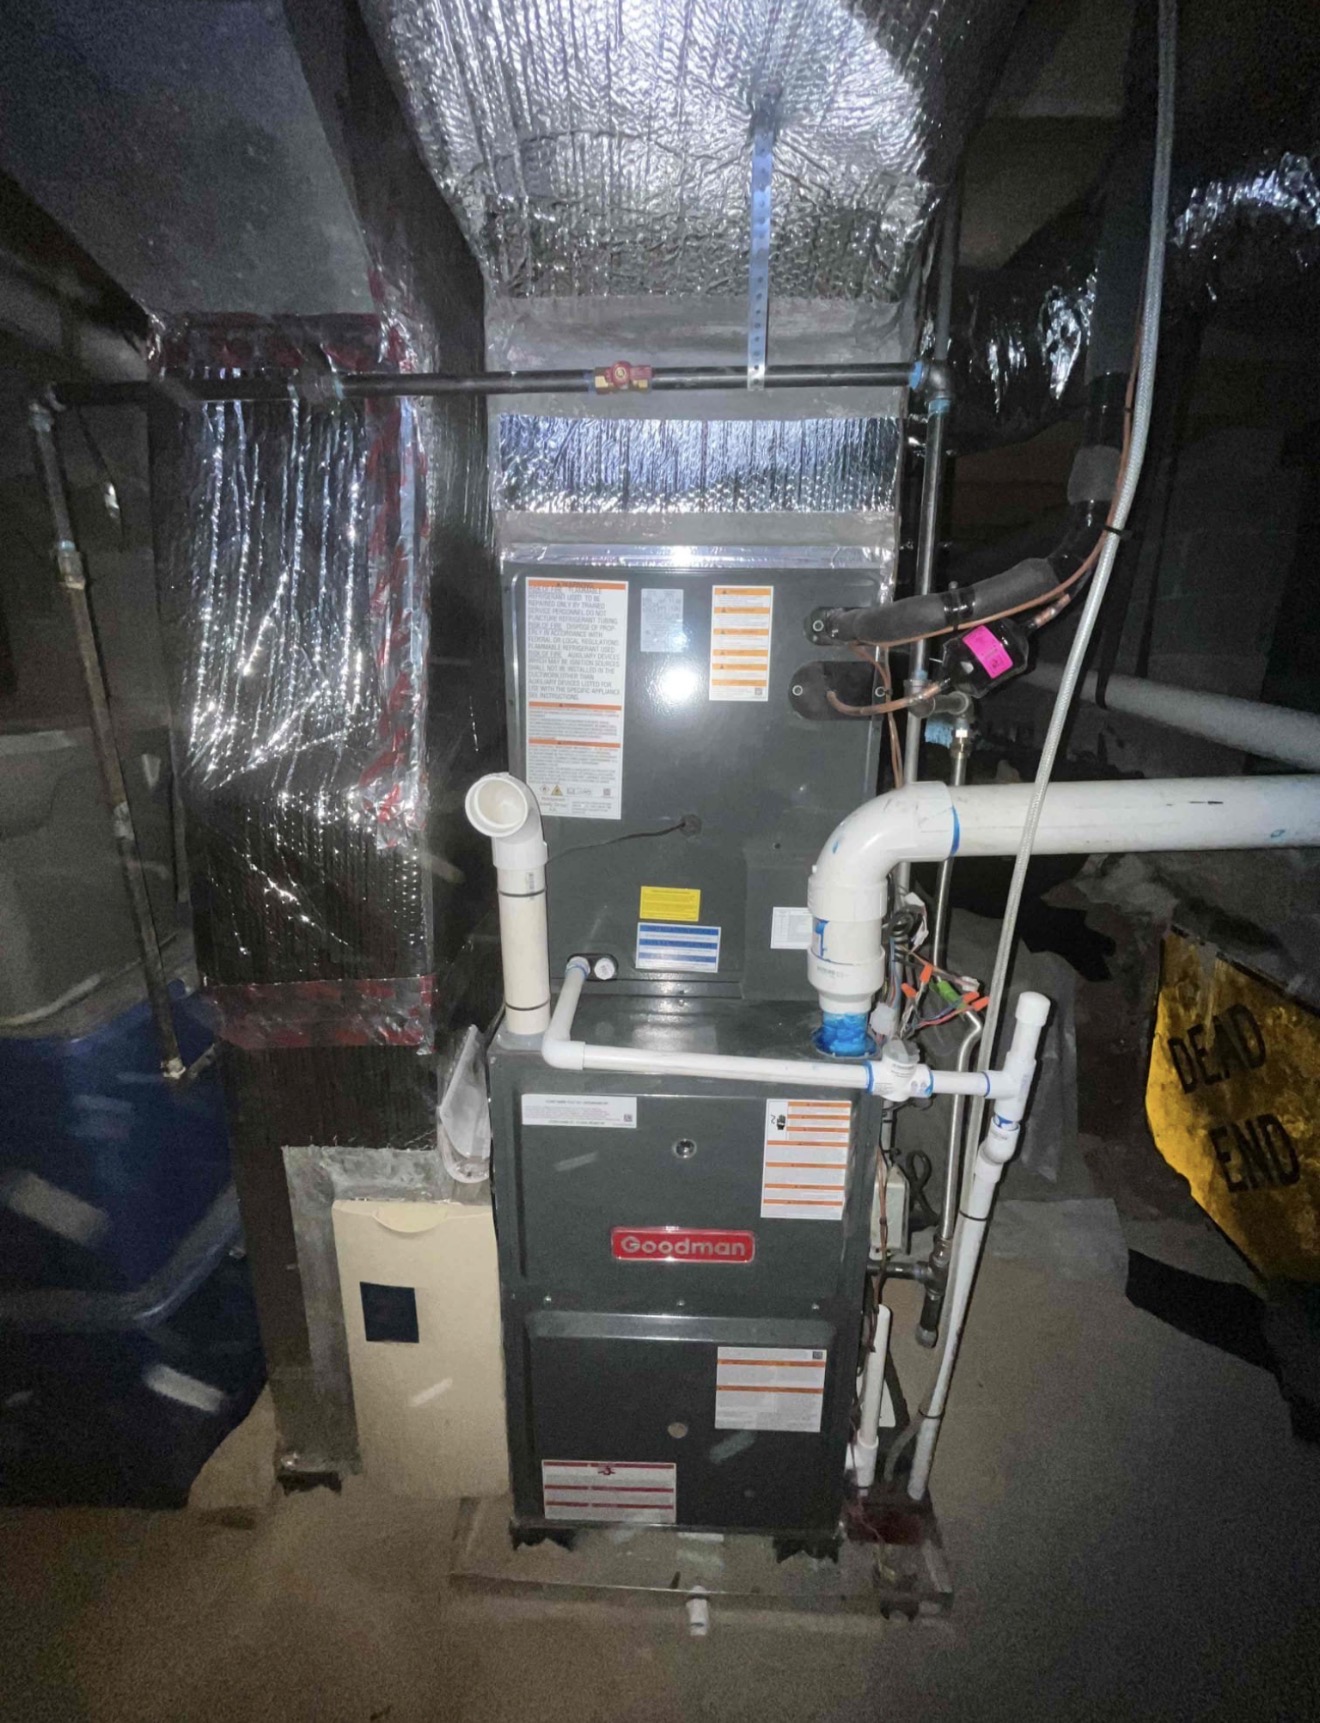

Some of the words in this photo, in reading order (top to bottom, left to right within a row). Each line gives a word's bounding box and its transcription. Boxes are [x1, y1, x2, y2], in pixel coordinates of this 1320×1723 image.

[1167, 1004, 1267, 1095] DEAD
[1208, 1113, 1300, 1193] END
[620, 1236, 745, 1256] Goodman
